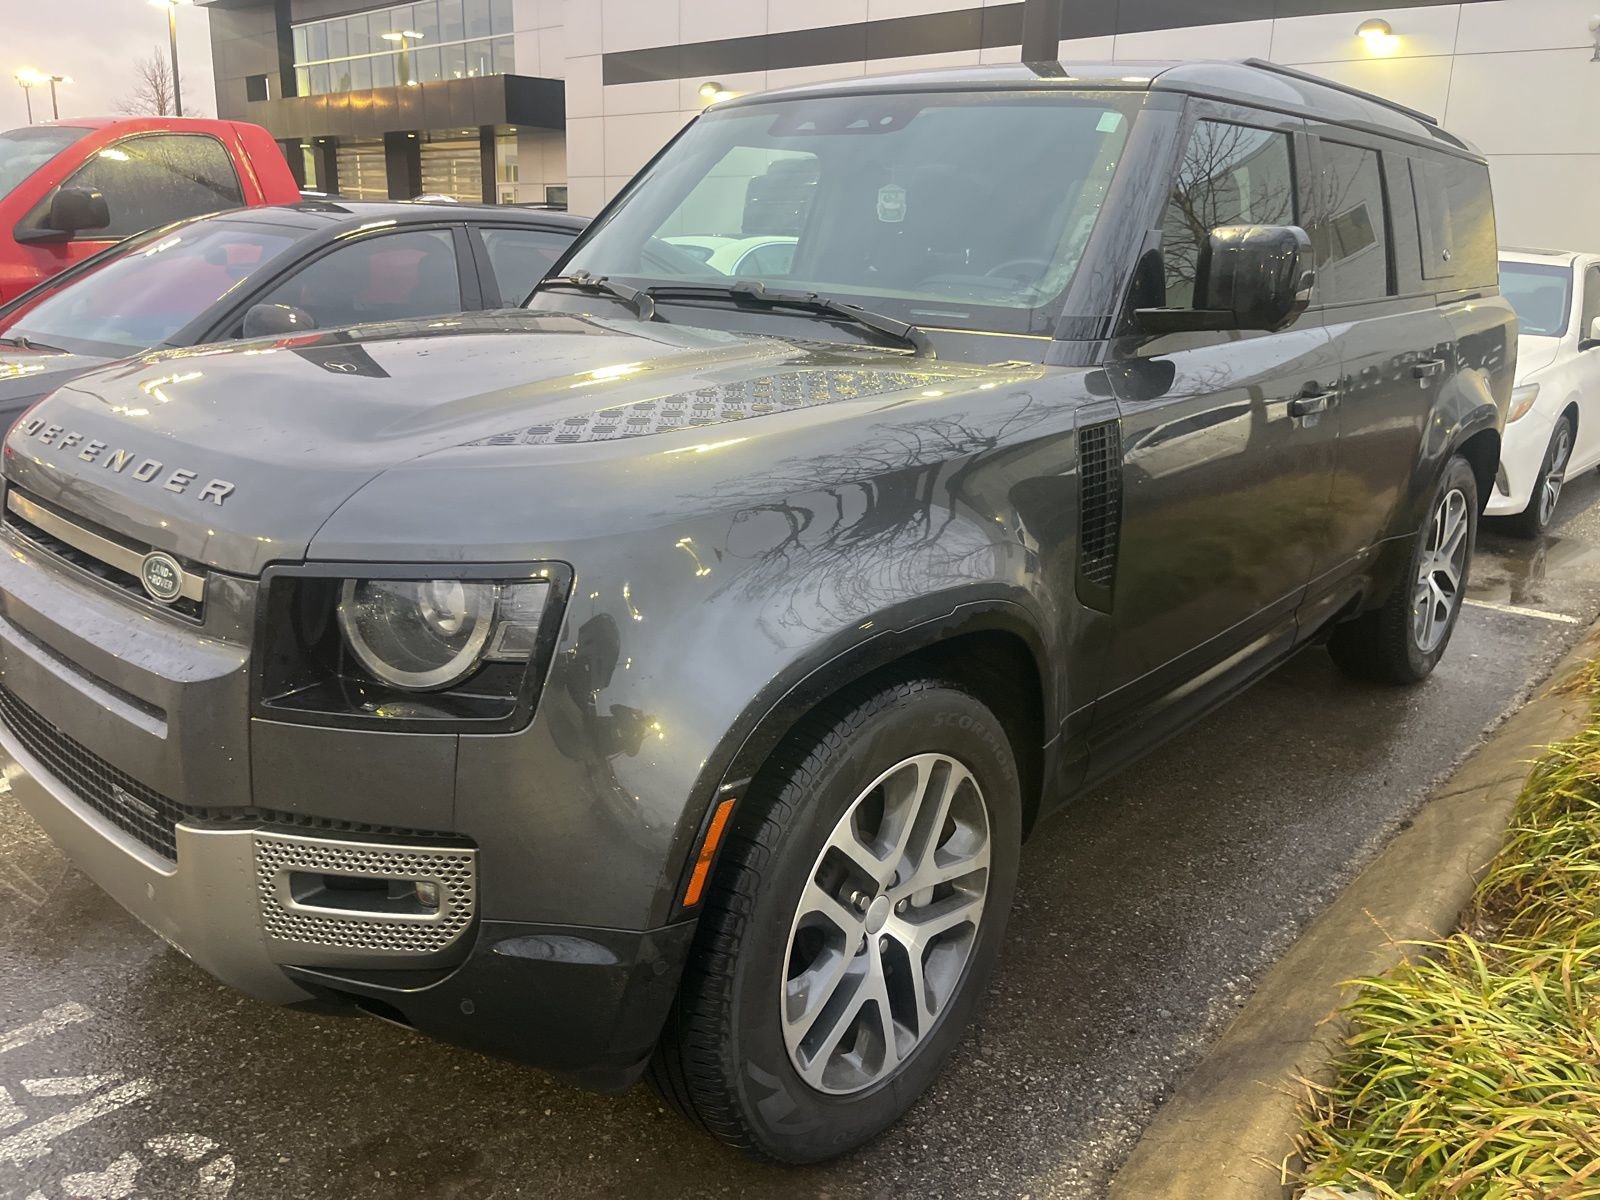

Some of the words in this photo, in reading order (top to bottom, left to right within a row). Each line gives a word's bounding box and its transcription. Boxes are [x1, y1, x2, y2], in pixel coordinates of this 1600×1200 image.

[24, 417, 236, 506] DEFENDER
[151, 562, 170, 578] LAND
[151, 574, 173, 591] ROVER
